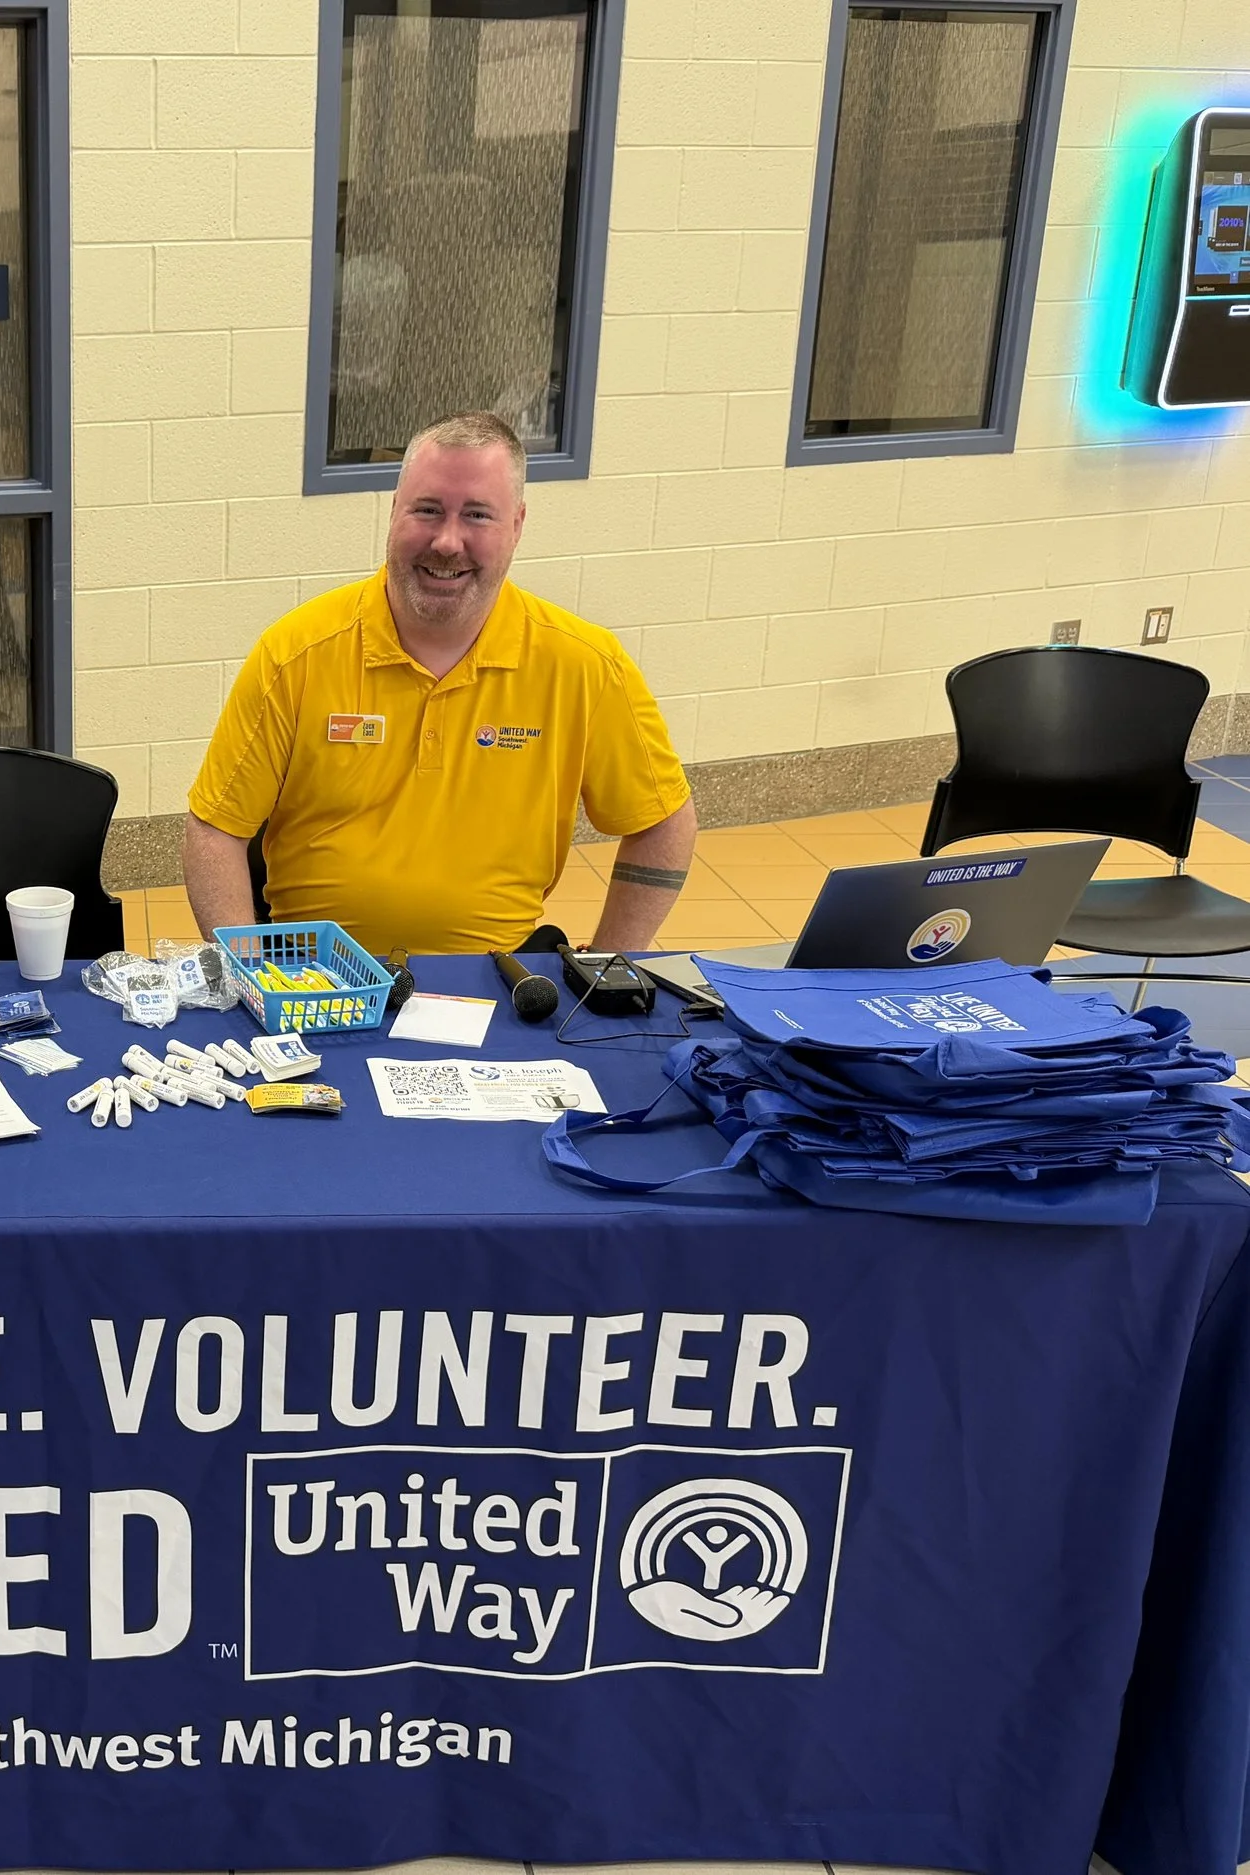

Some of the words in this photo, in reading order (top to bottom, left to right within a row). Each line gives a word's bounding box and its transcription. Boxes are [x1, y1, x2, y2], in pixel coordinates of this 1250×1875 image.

[499, 726, 525, 736] UNITED
[526, 728, 541, 738] WAY
[926, 867, 964, 884] UNITED
[965, 866, 975, 879] IS
[975, 864, 993, 878] THE
[90, 1310, 839, 1435] VOLUNTEER.
[266, 1473, 580, 1558] United
[385, 1562, 576, 1663] Way
[220, 1713, 514, 1768] Michigan
